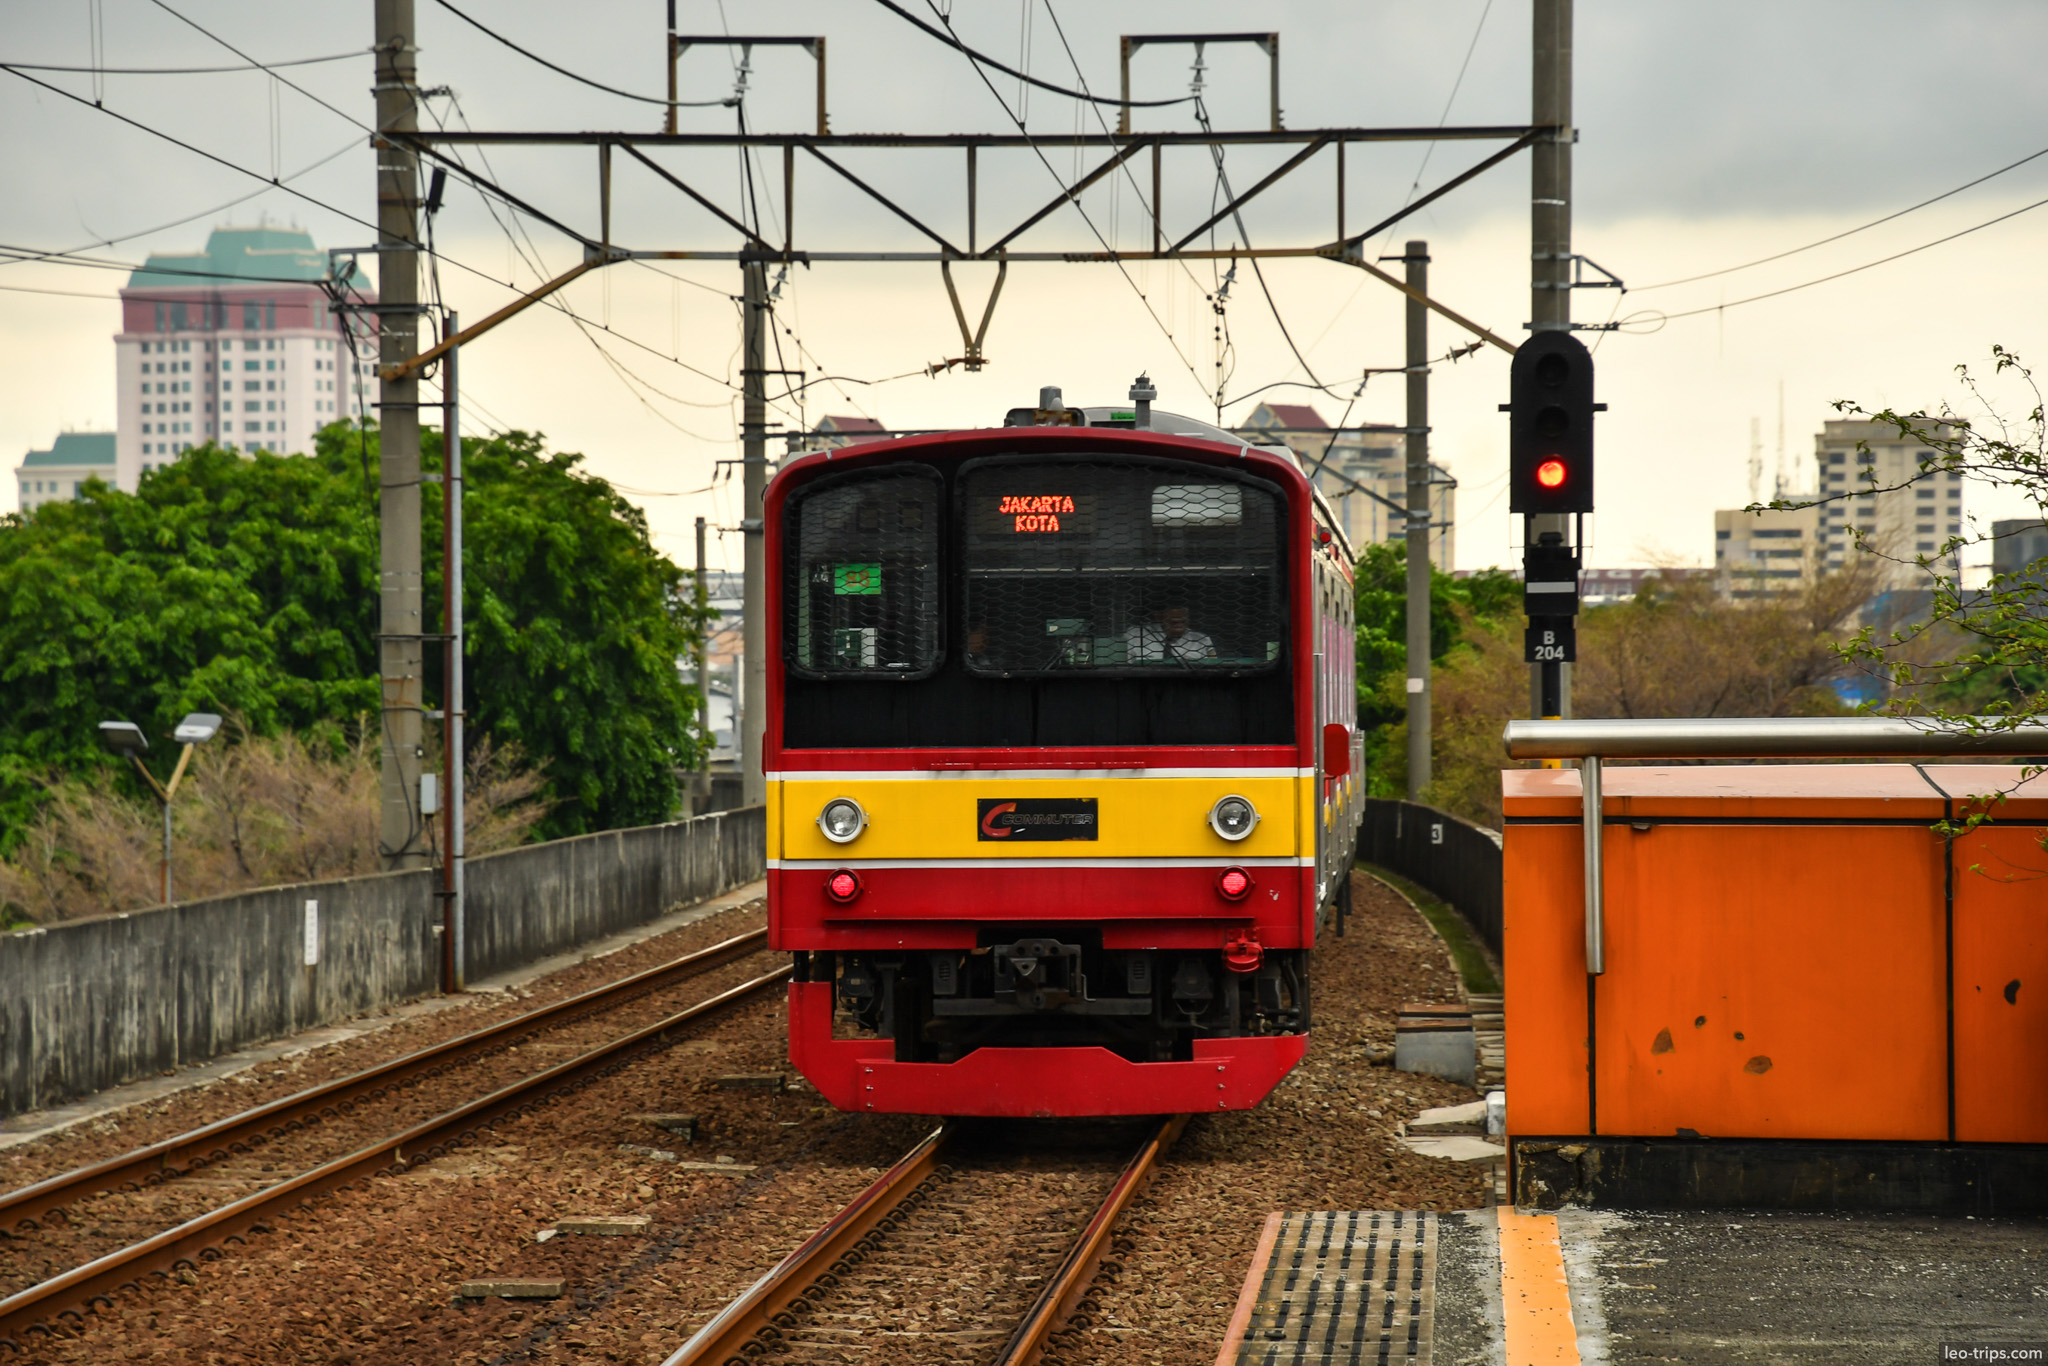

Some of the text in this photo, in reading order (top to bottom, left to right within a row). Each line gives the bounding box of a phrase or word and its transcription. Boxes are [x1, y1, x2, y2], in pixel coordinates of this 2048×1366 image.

[998, 495, 1075, 513] JAKARTA
[1015, 514, 1060, 532] KOTA
[1543, 630, 1555, 645] B
[1535, 645, 1565, 660] 204
[1001, 813, 1095, 825] COMMUTER
